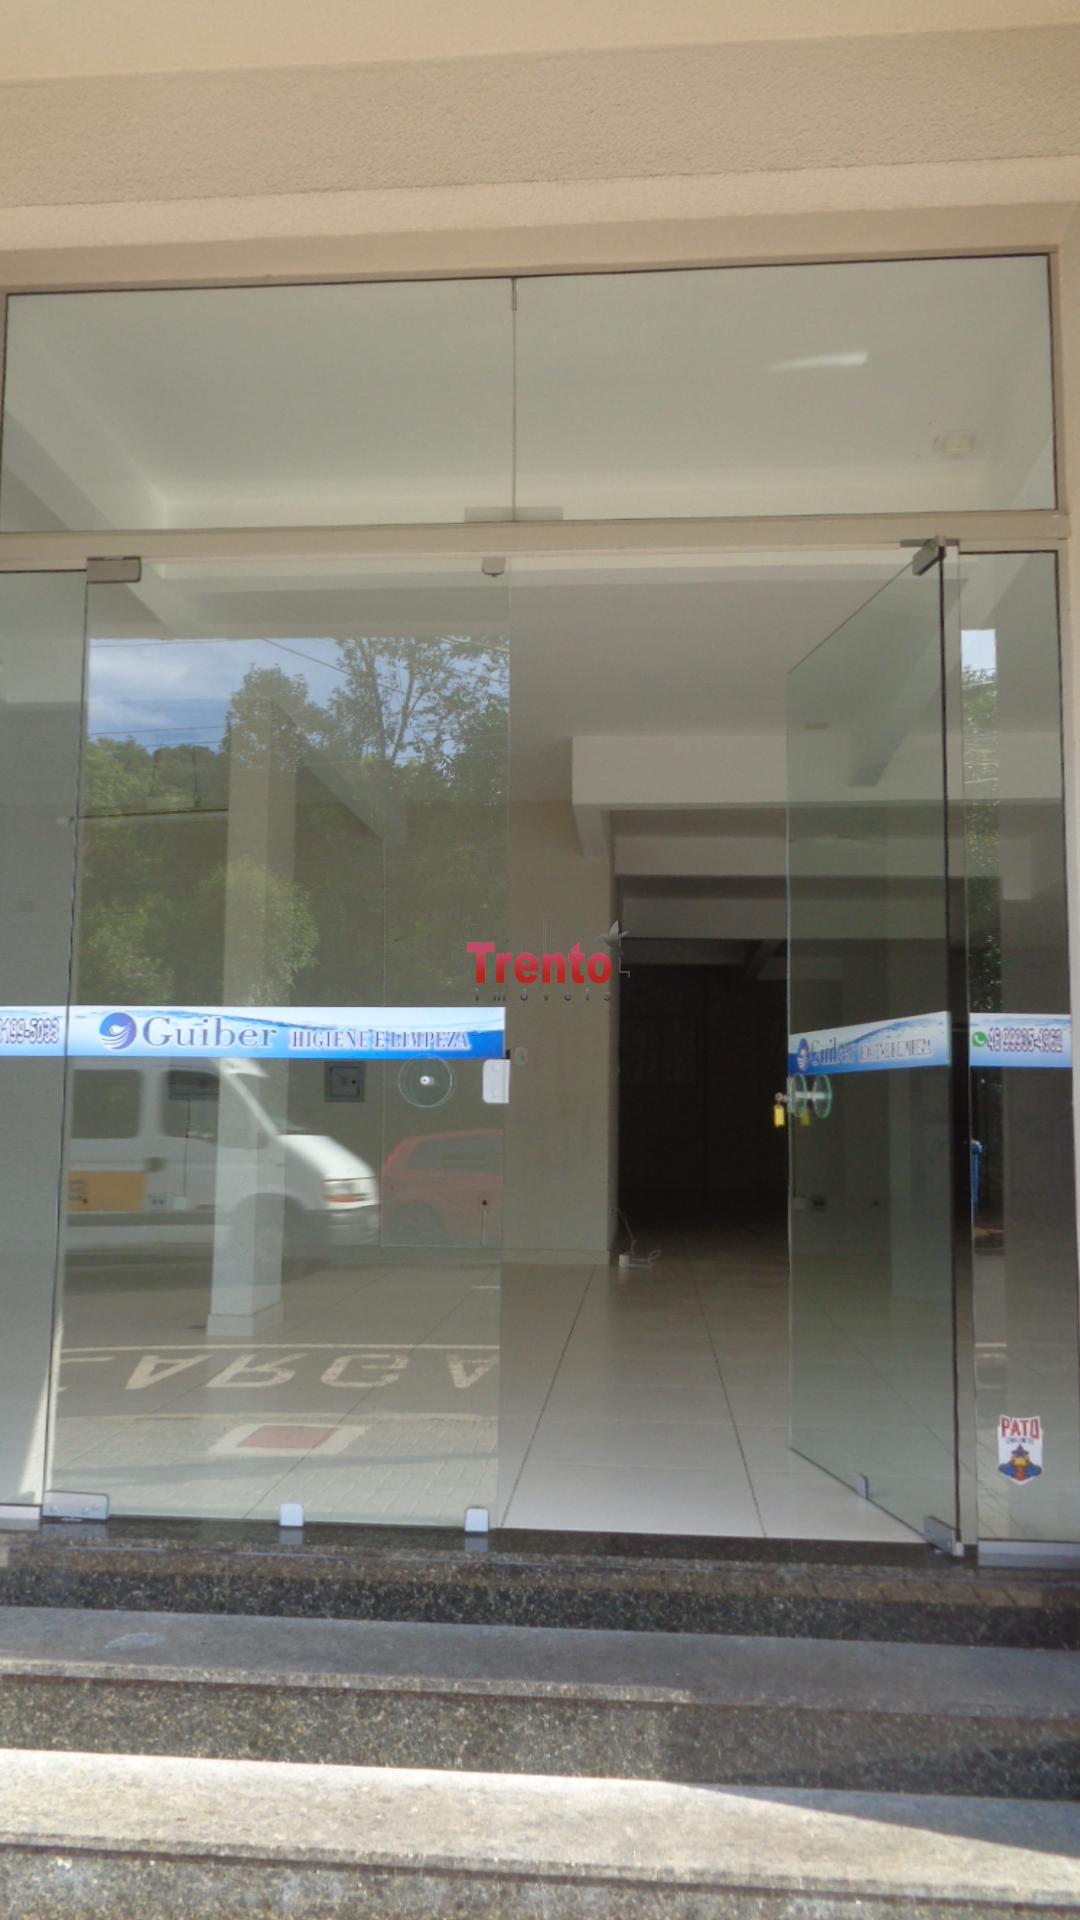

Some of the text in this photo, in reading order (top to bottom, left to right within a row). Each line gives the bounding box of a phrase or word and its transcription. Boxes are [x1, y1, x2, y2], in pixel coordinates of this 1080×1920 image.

[143, 1016, 277, 1047] Guiber
[292, 1031, 369, 1048] HIGIENE
[390, 1031, 468, 1048] LIMPEZA
[1001, 1416, 1039, 1439] PATO
